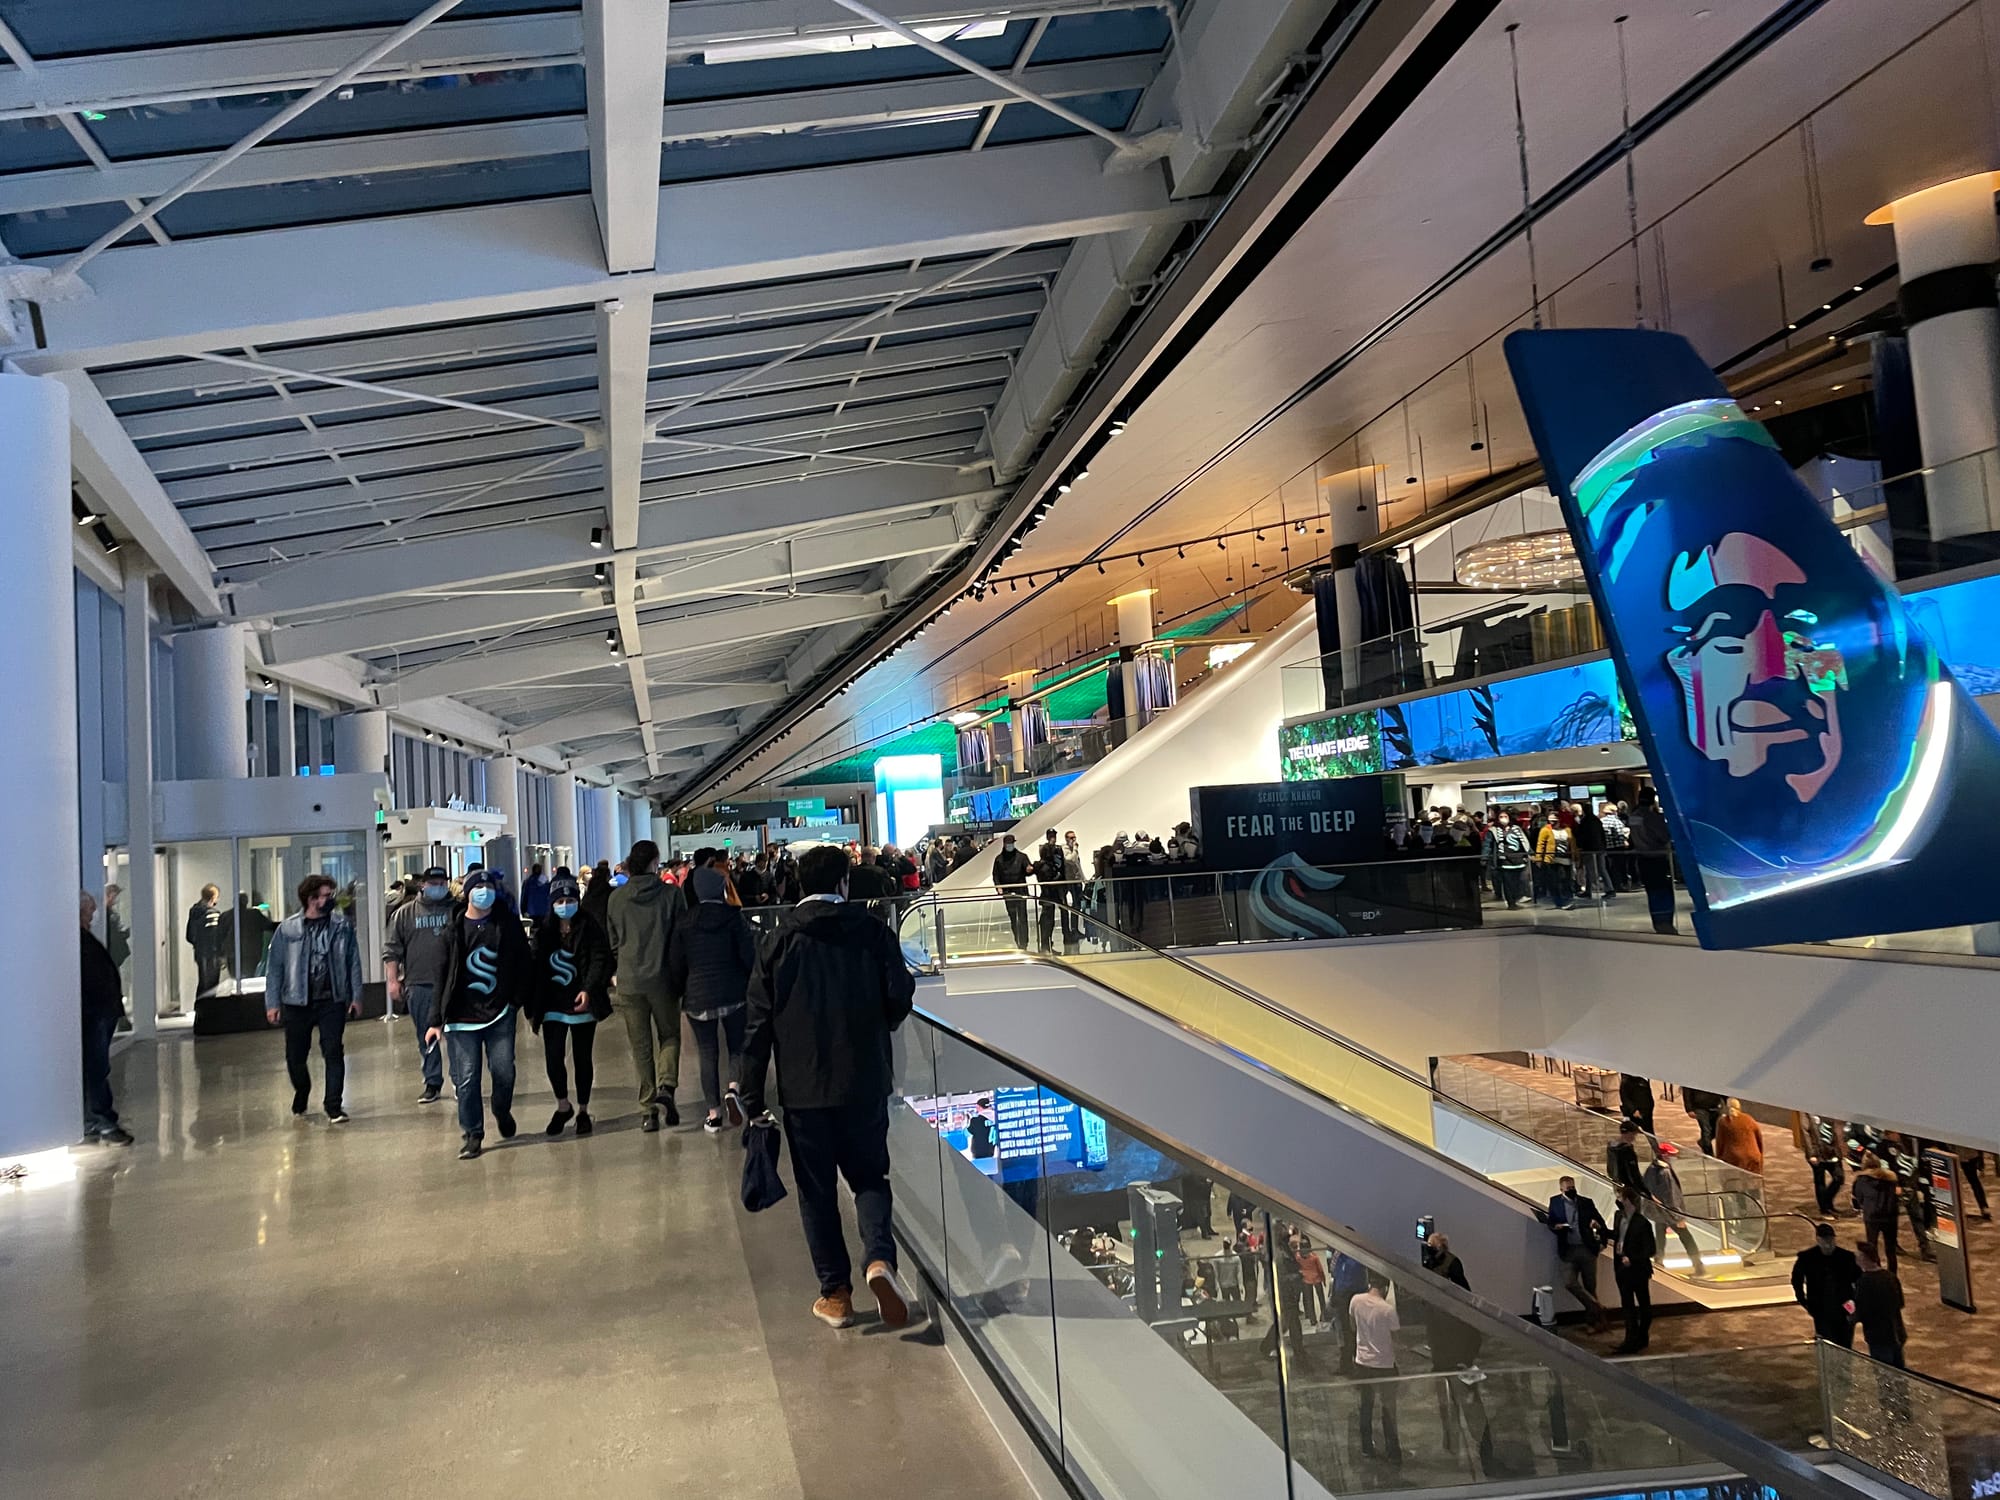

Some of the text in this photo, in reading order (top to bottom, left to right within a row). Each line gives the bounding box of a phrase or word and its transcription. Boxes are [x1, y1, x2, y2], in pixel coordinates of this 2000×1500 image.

[1288, 735, 1370, 761] THE CLIMATE PLEDGE
[1226, 809, 1356, 838] FEAR THE DEEP
